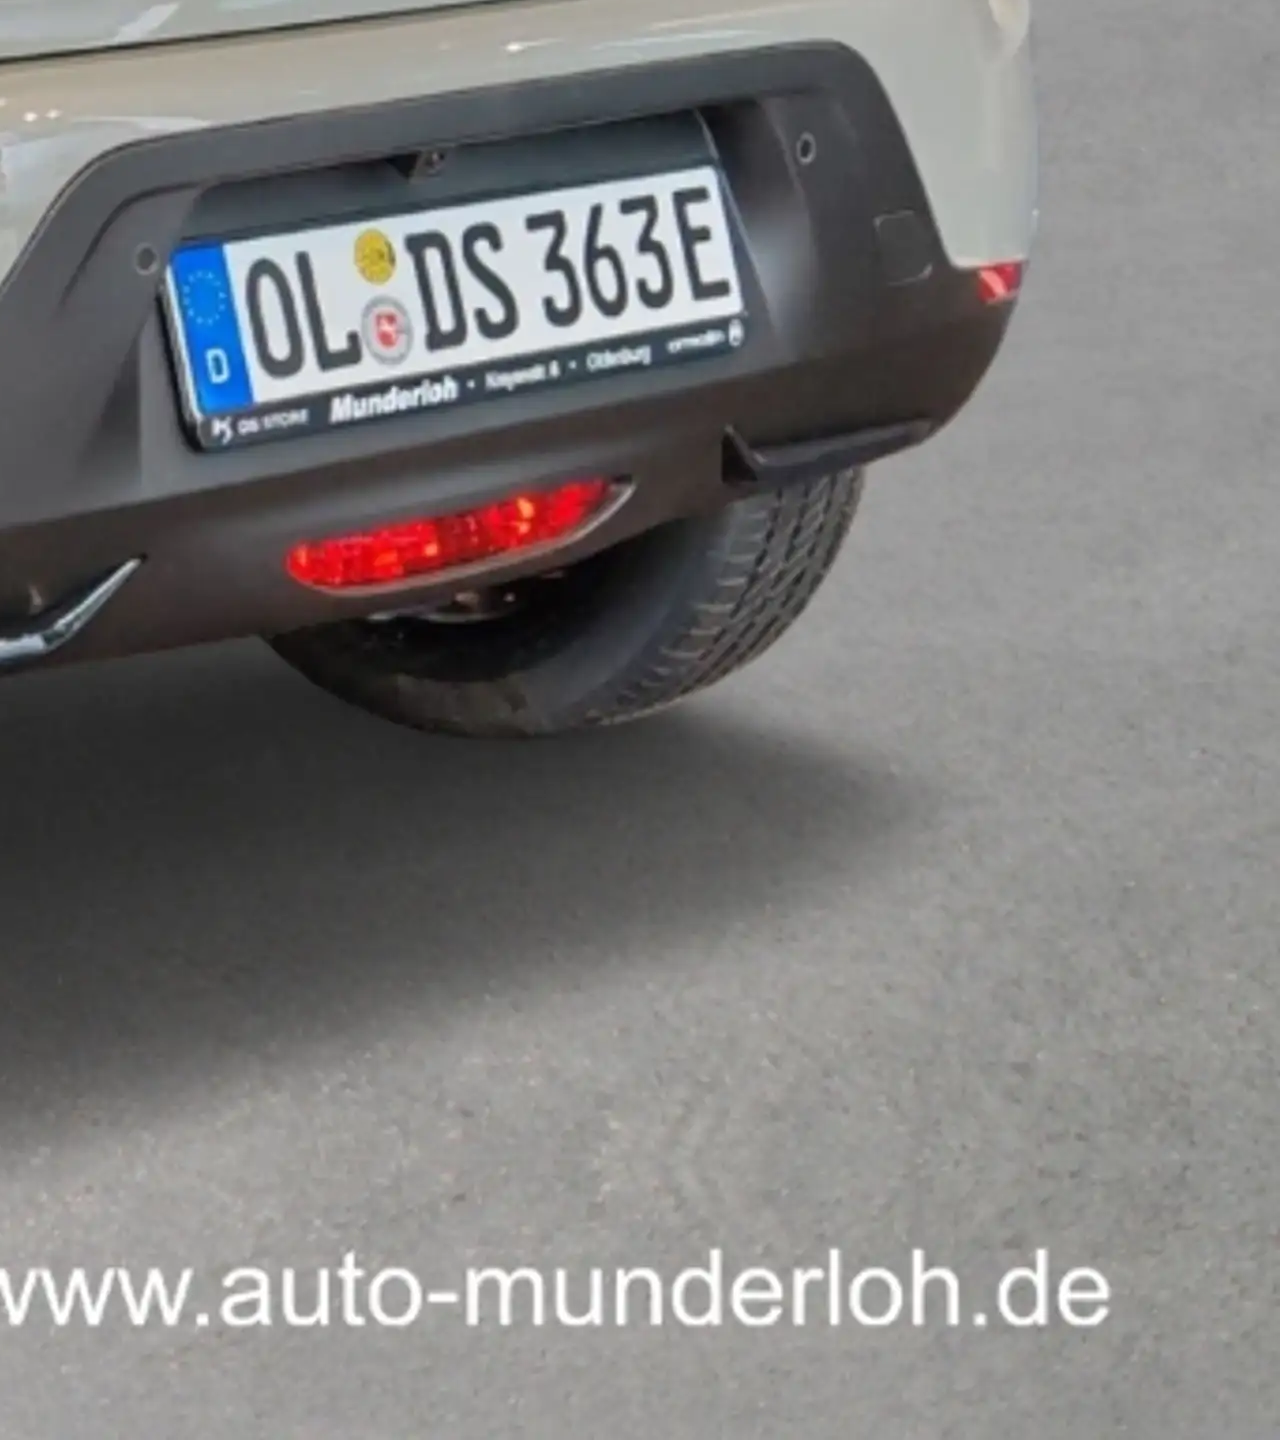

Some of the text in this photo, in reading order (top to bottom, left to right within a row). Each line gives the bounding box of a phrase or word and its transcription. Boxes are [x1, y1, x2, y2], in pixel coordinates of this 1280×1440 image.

[245, 187, 731, 380] OL DS 363E
[205, 347, 231, 384] D
[330, 374, 459, 424] Munderloh
